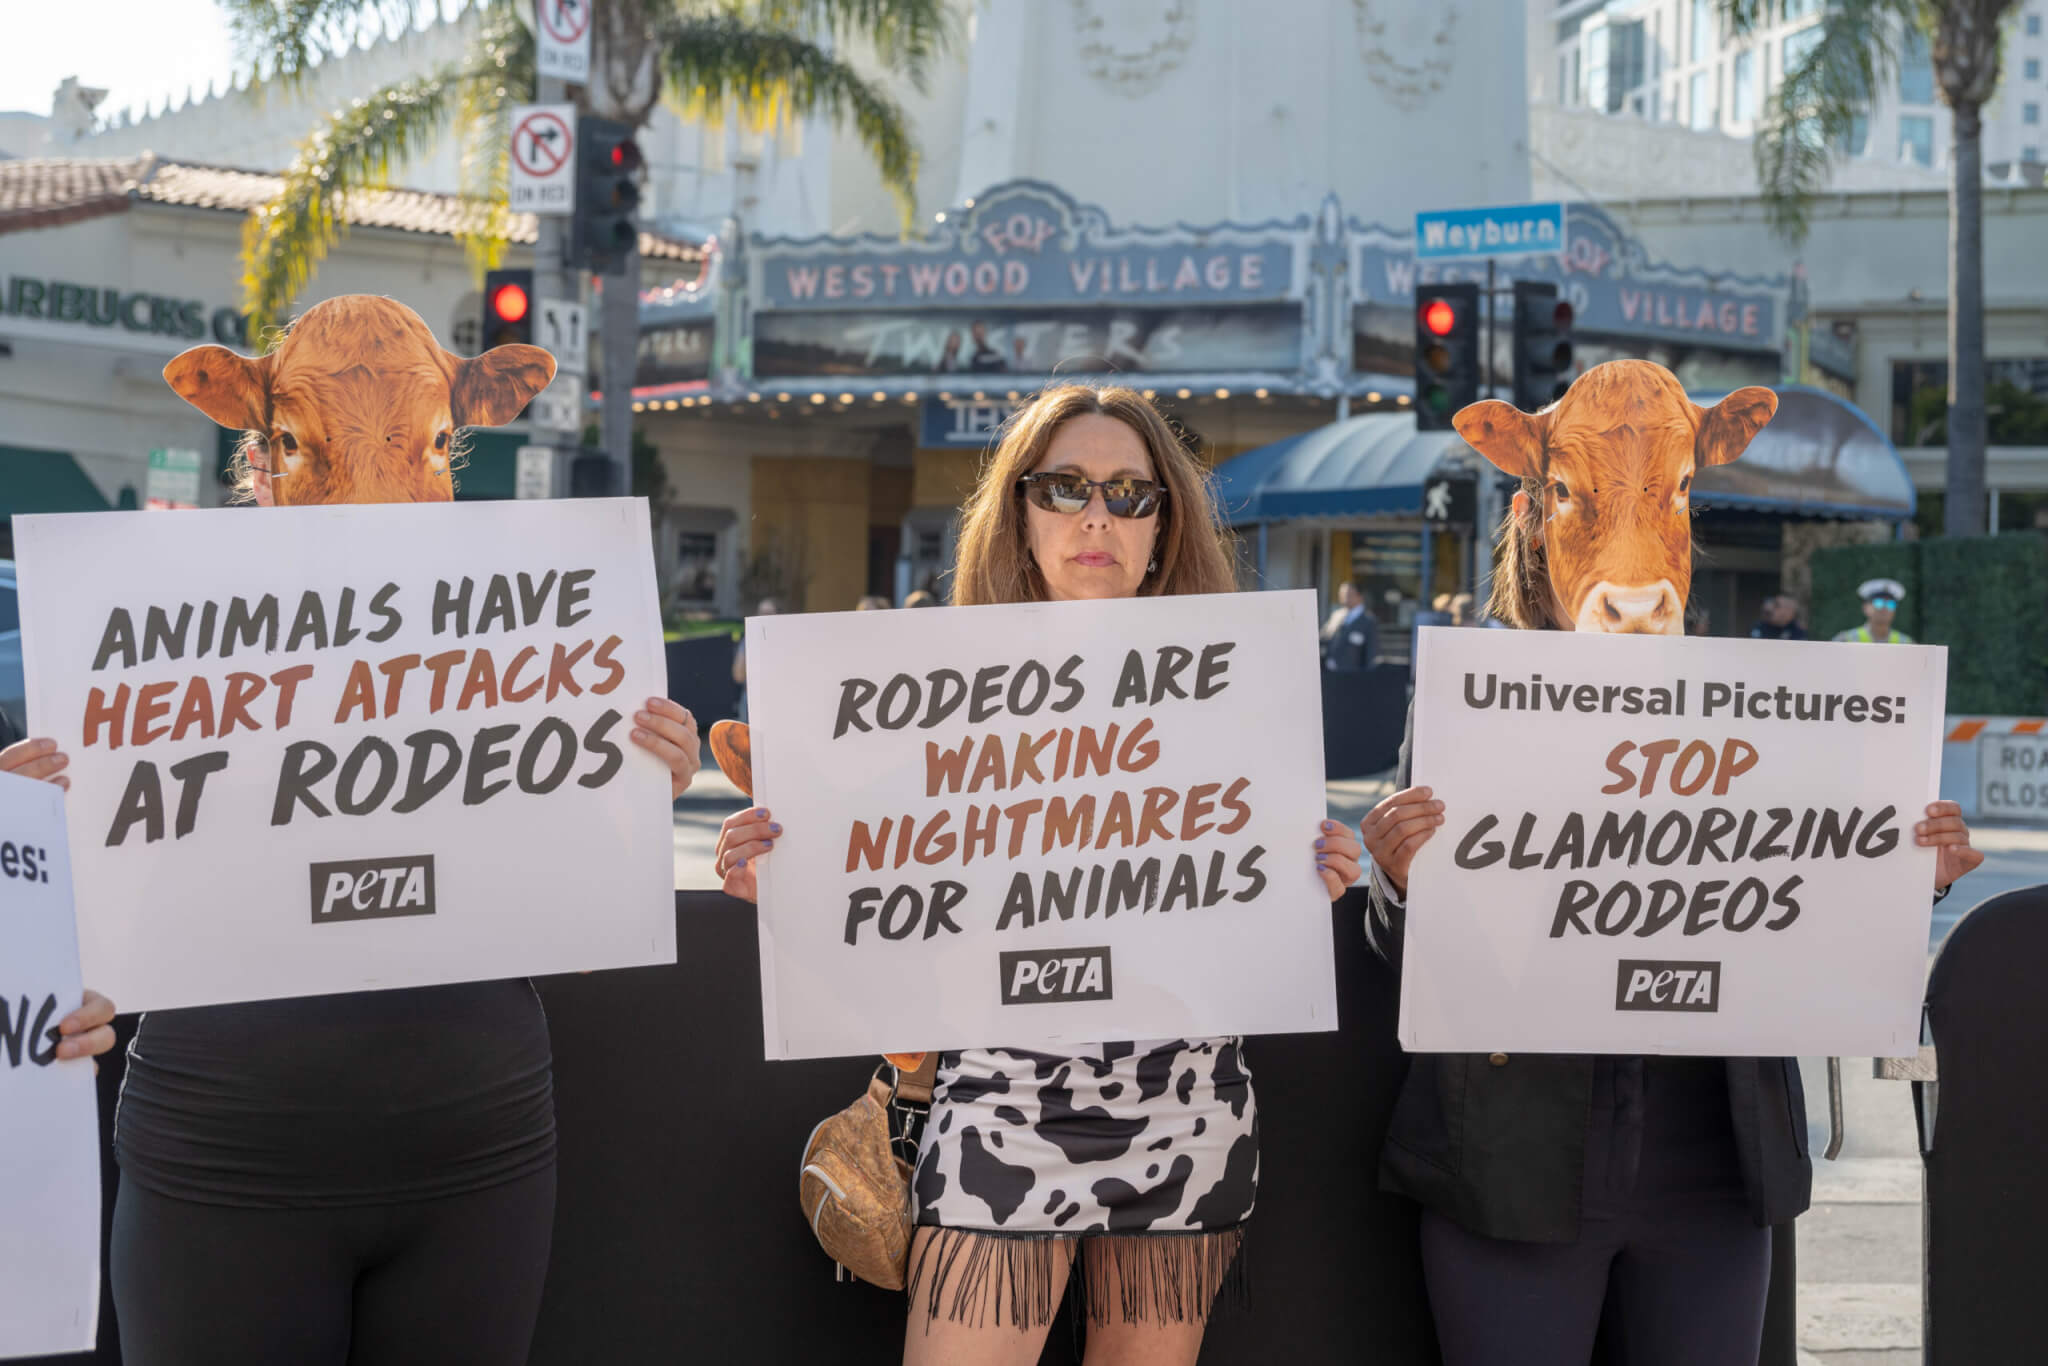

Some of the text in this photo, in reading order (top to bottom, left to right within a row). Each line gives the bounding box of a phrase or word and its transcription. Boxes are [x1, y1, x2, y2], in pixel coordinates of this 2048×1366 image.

[983, 213, 1056, 255] FOX
[1423, 217, 1555, 252] Weyburn
[0, 276, 205, 339] RBUCKS
[786, 254, 1266, 298] WESTWOOD VILLAGE
[1619, 287, 1760, 336] VILLAGE
[95, 570, 595, 670] ANIMALS HAVE
[84, 636, 624, 749] HEART ATTACKS
[834, 643, 1235, 739] RODEOS ARE
[1464, 673, 1905, 723] Universal Pictures:
[106, 709, 623, 847] AT RODEOS
[926, 718, 1159, 796] WAKING
[1602, 739, 1758, 798] STOP
[846, 778, 1250, 872] NIGHTMARES
[1455, 805, 1899, 870] GLAMORIZING
[844, 845, 1266, 946] FOR ANIMALS
[1549, 875, 1803, 938] RODEOS
